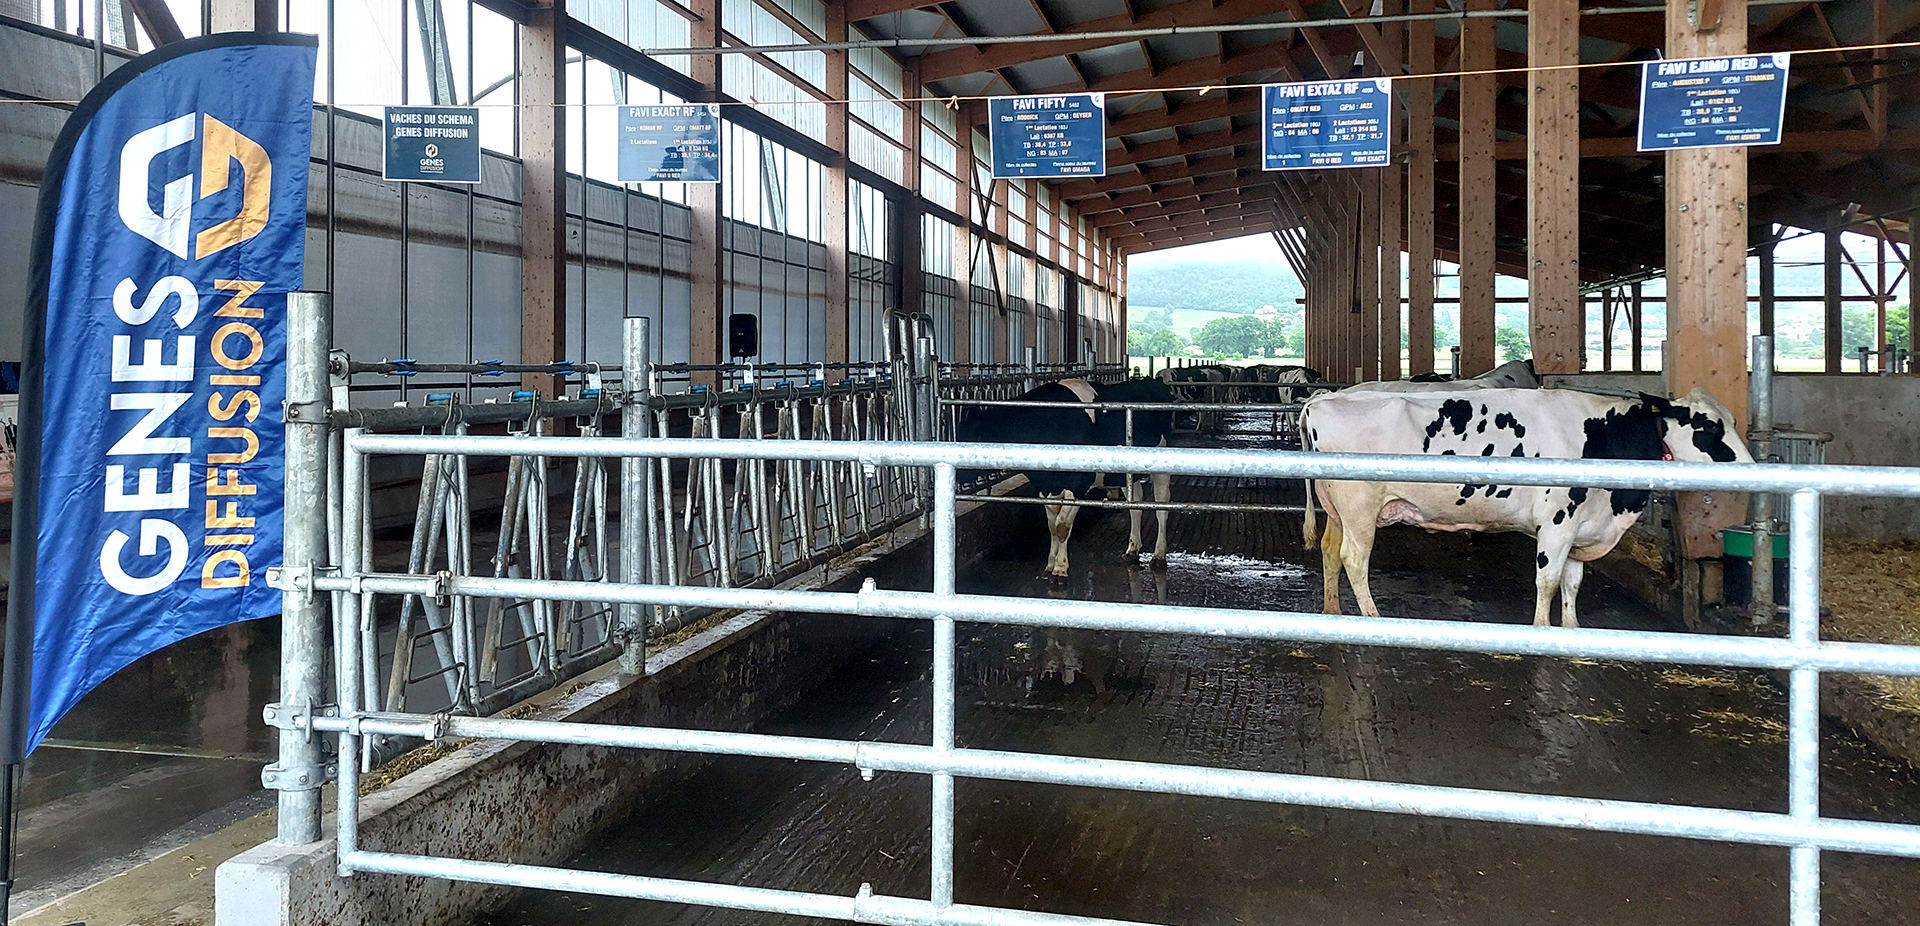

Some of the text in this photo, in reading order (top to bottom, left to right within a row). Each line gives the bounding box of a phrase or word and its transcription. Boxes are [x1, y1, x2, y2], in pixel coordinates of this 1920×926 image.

[1658, 62, 1687, 75] FAVI
[1689, 60, 1729, 73] EJIMO
[1731, 58, 1758, 70] RED
[1280, 86, 1304, 98] FAVI
[1307, 84, 1341, 96] EXTAZ
[1344, 83, 1359, 95] RF
[1013, 99, 1035, 110] FAVI
[1038, 97, 1066, 109] FIFTY
[390, 113, 474, 125] VACHES DU SCHEMA
[630, 108, 649, 117] FAVI
[652, 107, 681, 117] EXACT
[683, 107, 695, 117] RF
[395, 127, 468, 138] GENES DIFFUSION
[99, 274, 200, 596] GENES
[201, 279, 265, 589] DIFFUSION
